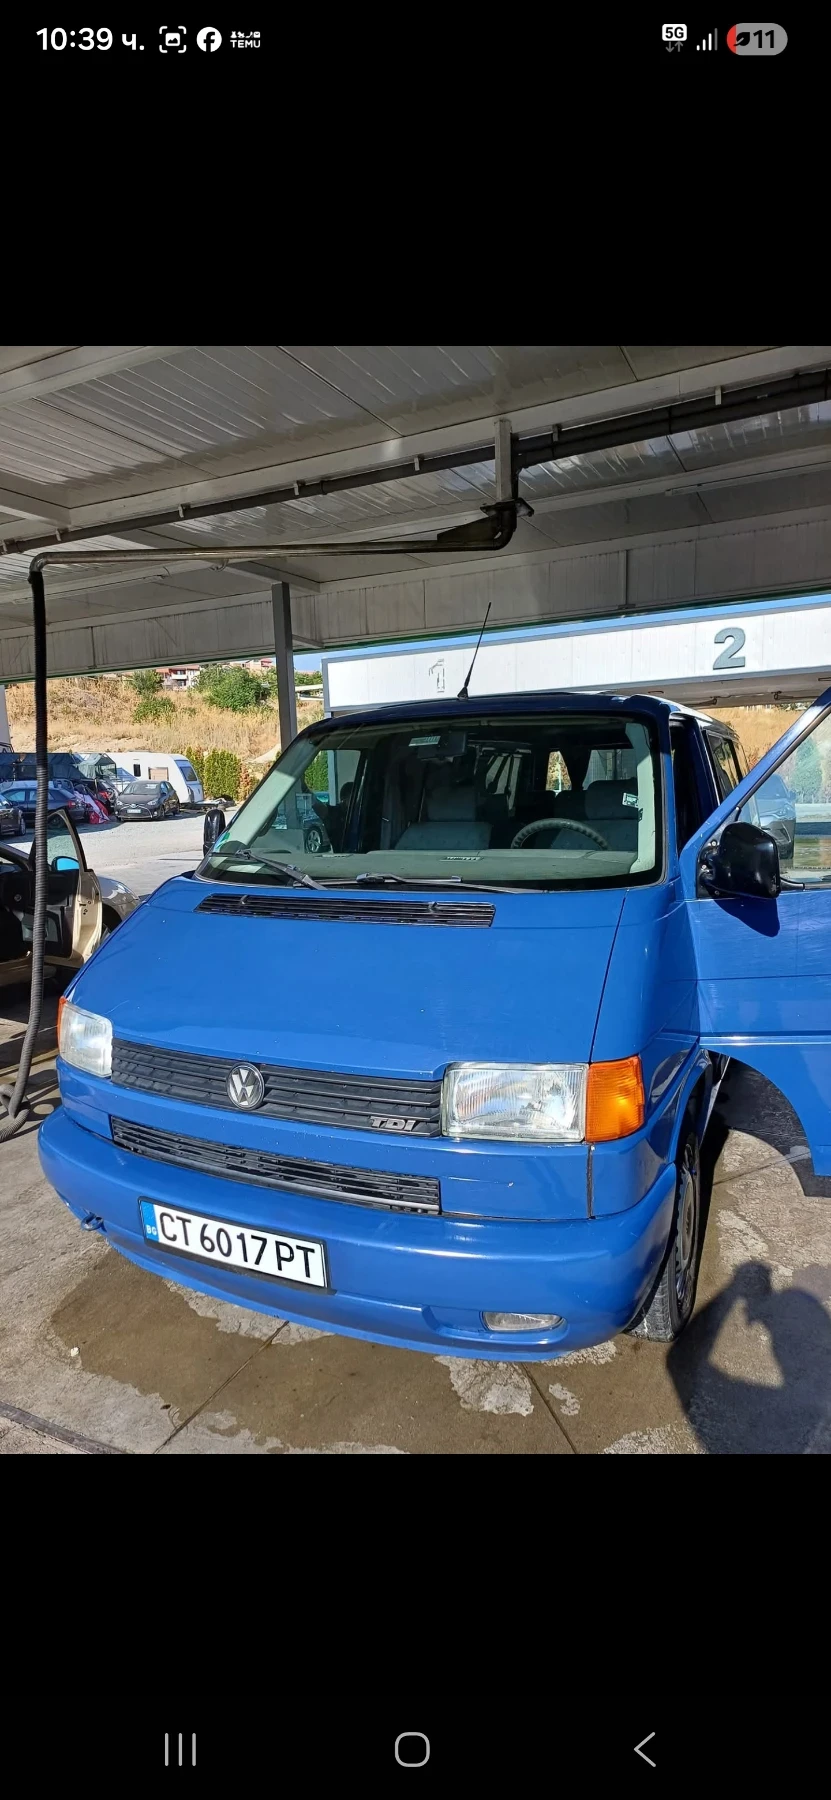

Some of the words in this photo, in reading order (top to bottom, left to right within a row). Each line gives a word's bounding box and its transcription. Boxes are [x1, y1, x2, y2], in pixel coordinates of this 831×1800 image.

[712, 627, 746, 671] 2
[370, 1115, 417, 1131] TDI
[146, 1224, 157, 1236] BG
